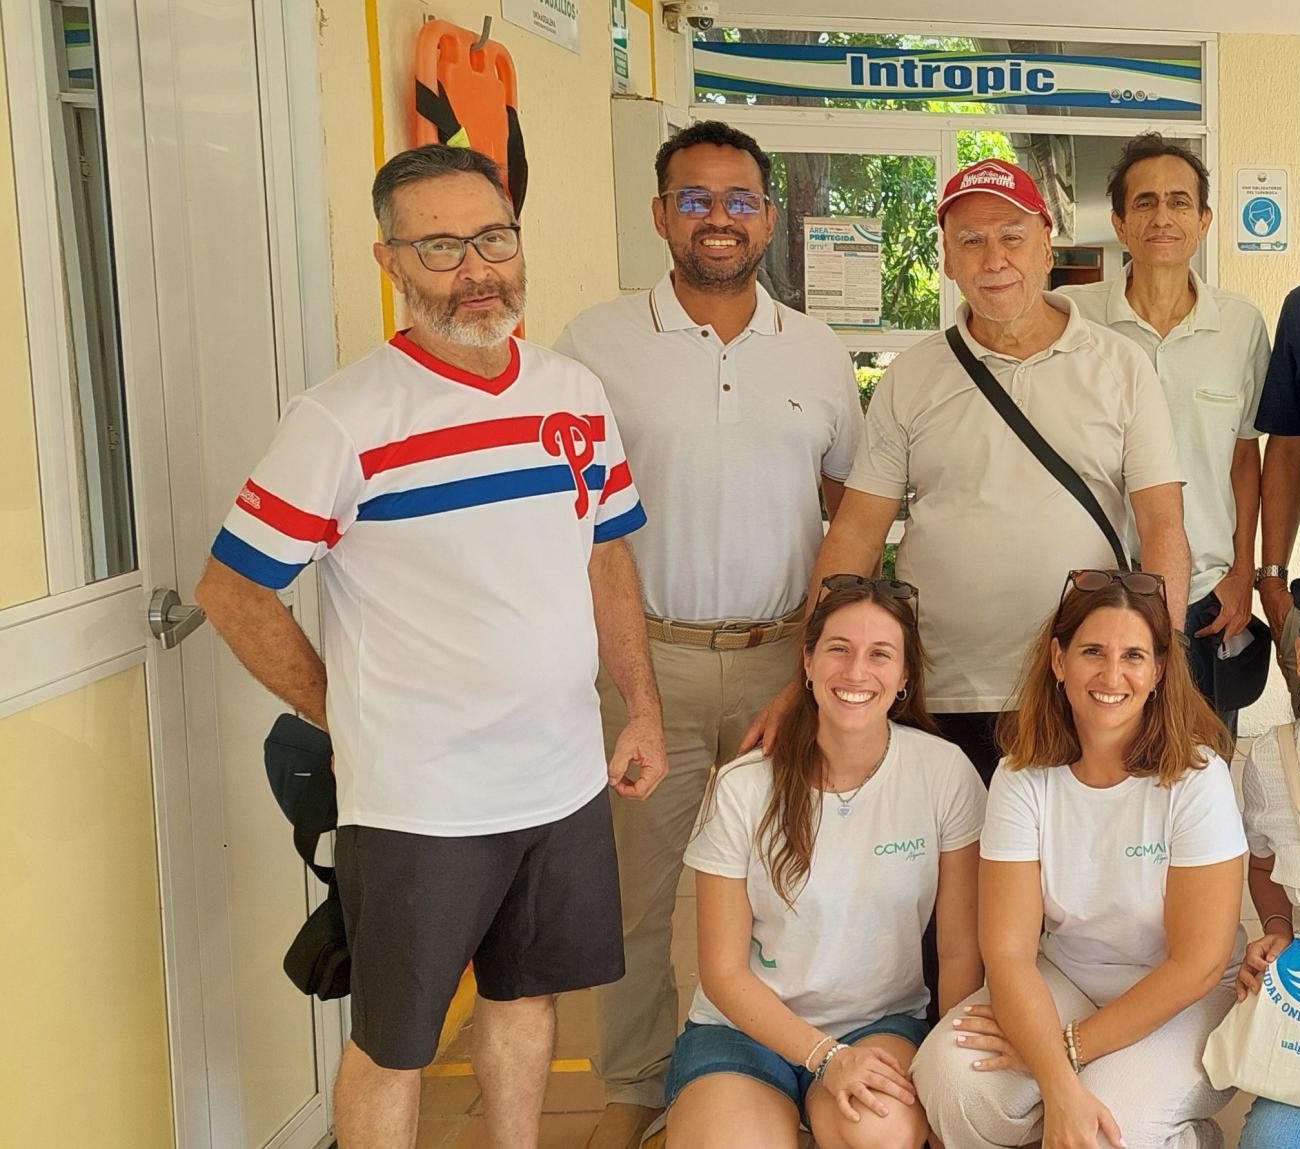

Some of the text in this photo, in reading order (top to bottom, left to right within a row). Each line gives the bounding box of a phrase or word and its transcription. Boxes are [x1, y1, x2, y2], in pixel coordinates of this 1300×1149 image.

[849, 55, 1055, 95] Intropic
[960, 177, 1016, 190] ADVENTURE
[809, 233, 855, 241] PROTEGIDA
[873, 838, 926, 856] CCMAR
